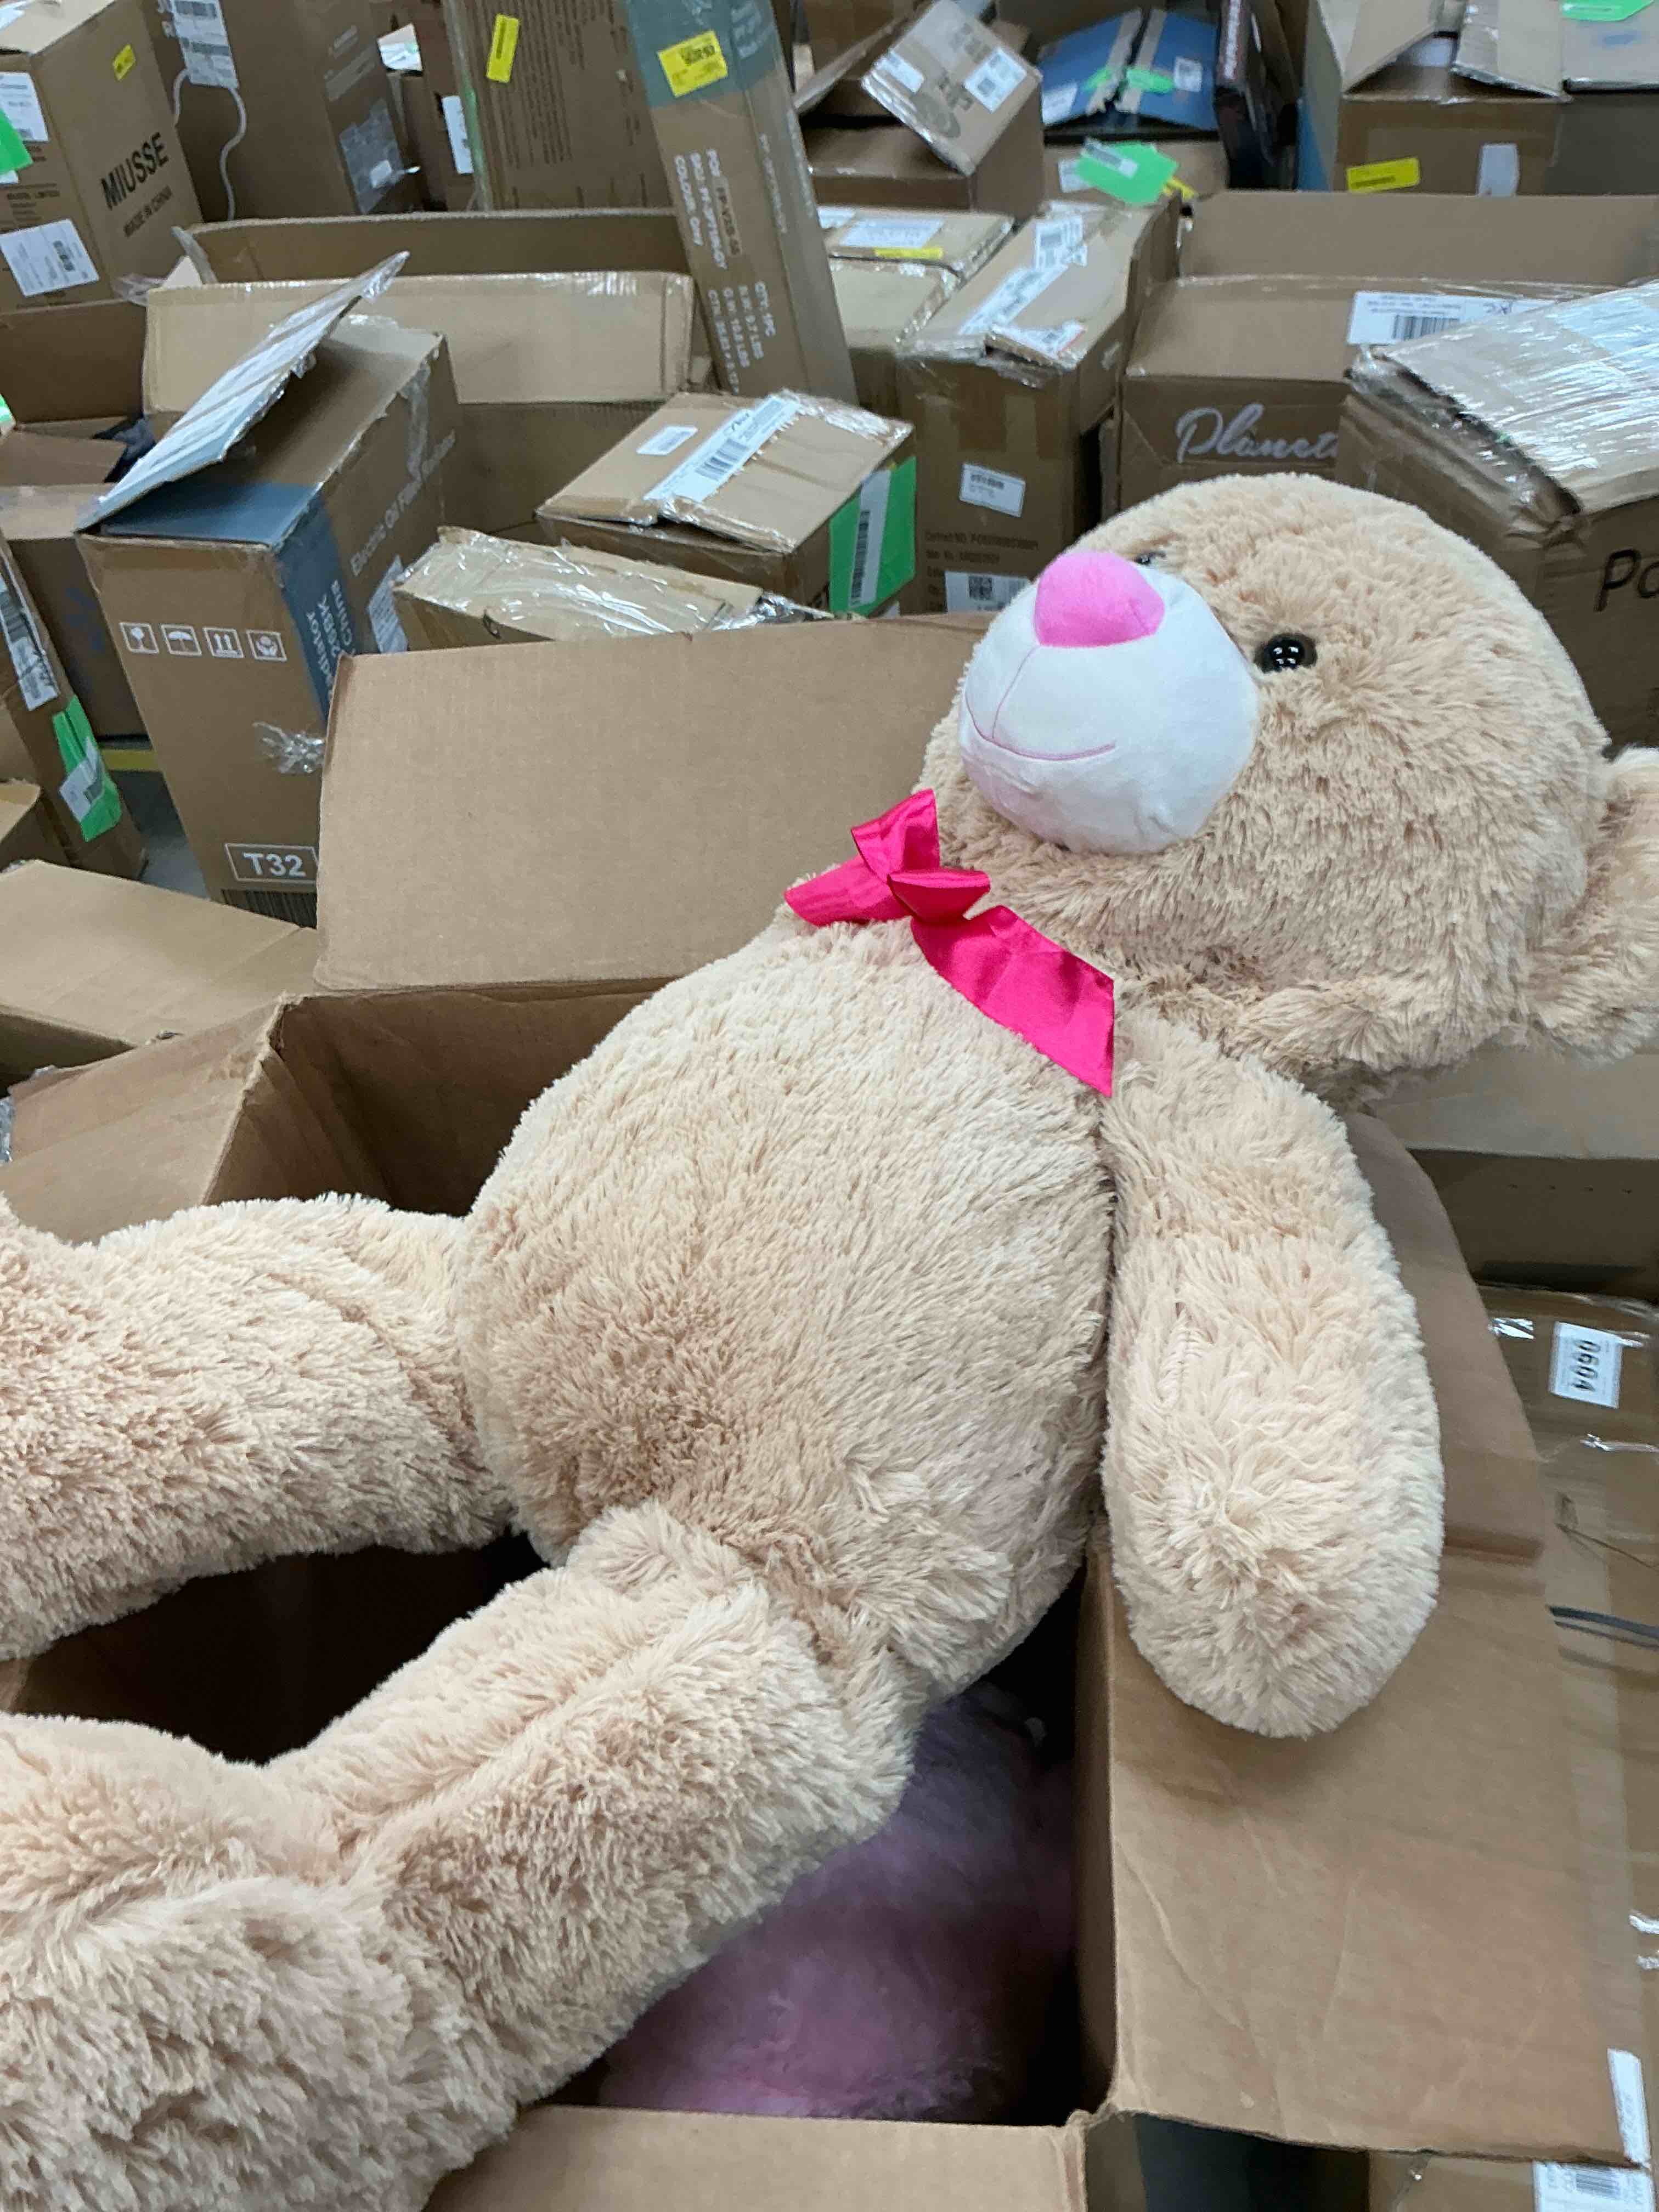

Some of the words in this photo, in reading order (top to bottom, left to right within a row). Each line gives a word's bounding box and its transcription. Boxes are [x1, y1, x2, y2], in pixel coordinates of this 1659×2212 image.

[101, 132, 169, 211] MIUSSE
[306, 611, 335, 702] adiator
[242, 851, 307, 878] T32
